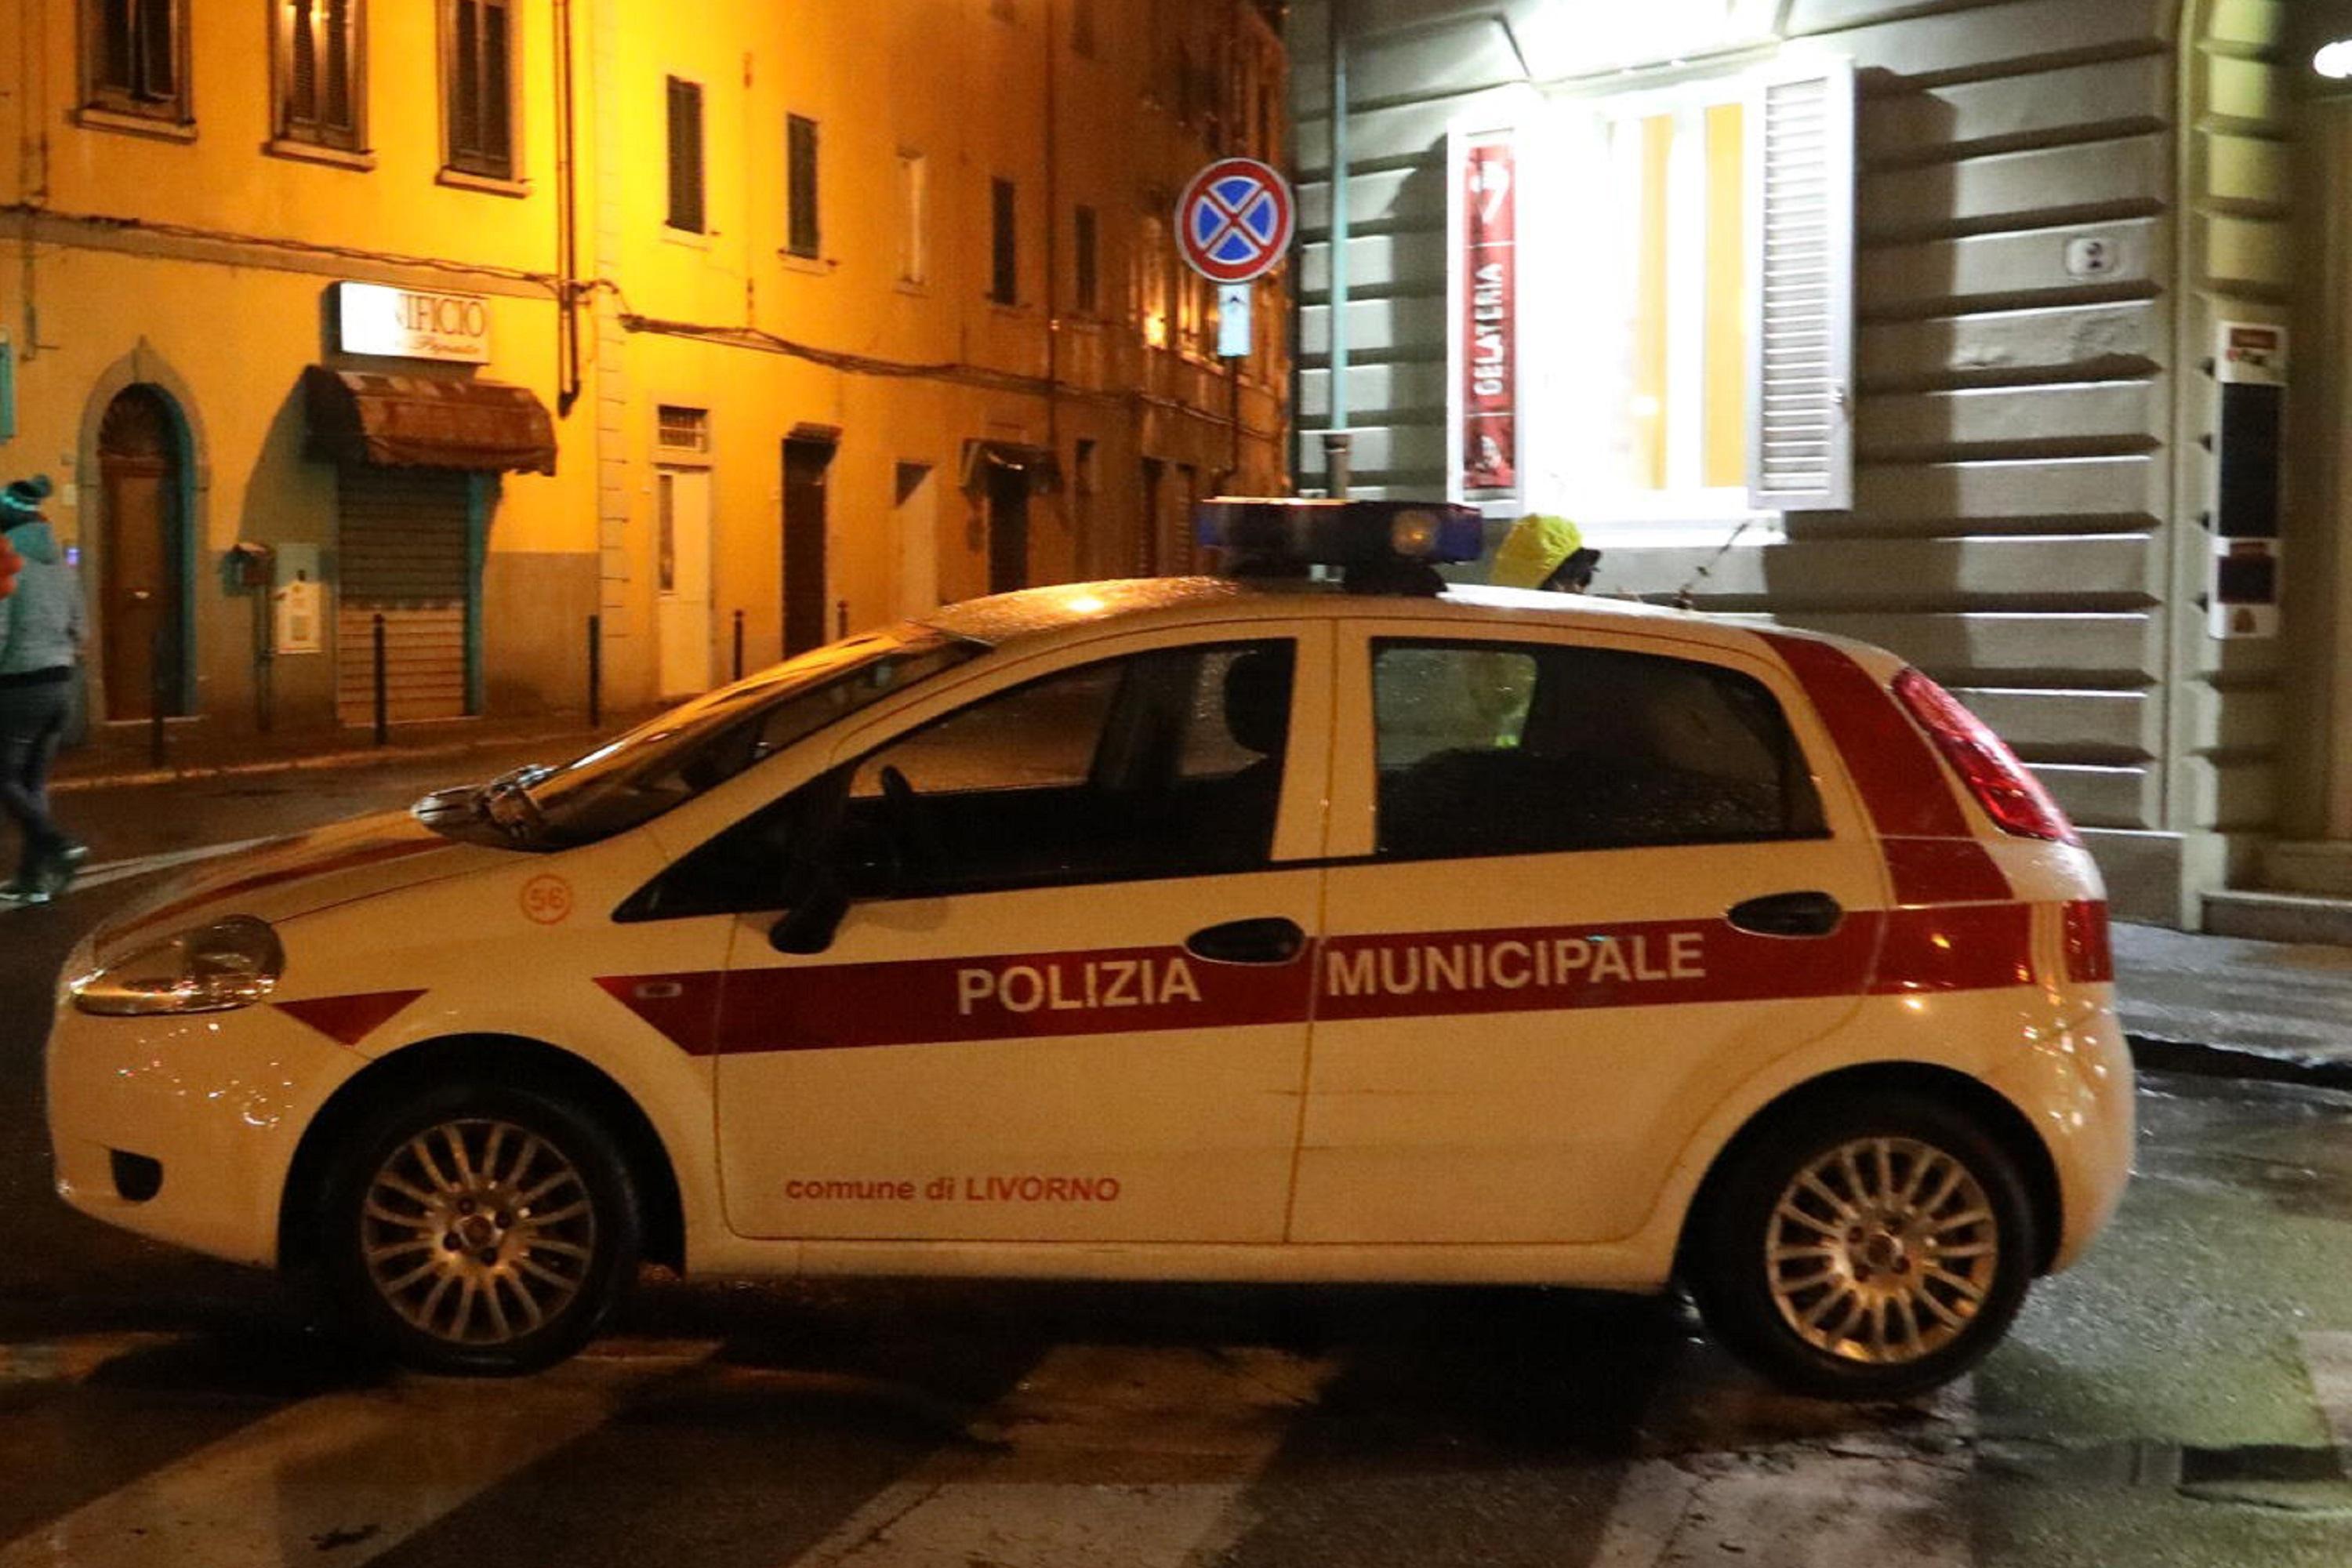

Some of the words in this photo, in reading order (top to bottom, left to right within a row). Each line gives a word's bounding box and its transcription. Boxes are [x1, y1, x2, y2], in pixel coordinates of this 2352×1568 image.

[1474, 263, 1503, 395] GELATERIA
[529, 887, 566, 912] 56
[957, 958, 1202, 1015] POLIZIA
[1327, 932, 1707, 996] MUNICIPALE
[786, 1179, 917, 1201] comune
[925, 1177, 954, 1201] di
[966, 1177, 1121, 1202] LIVORNO
